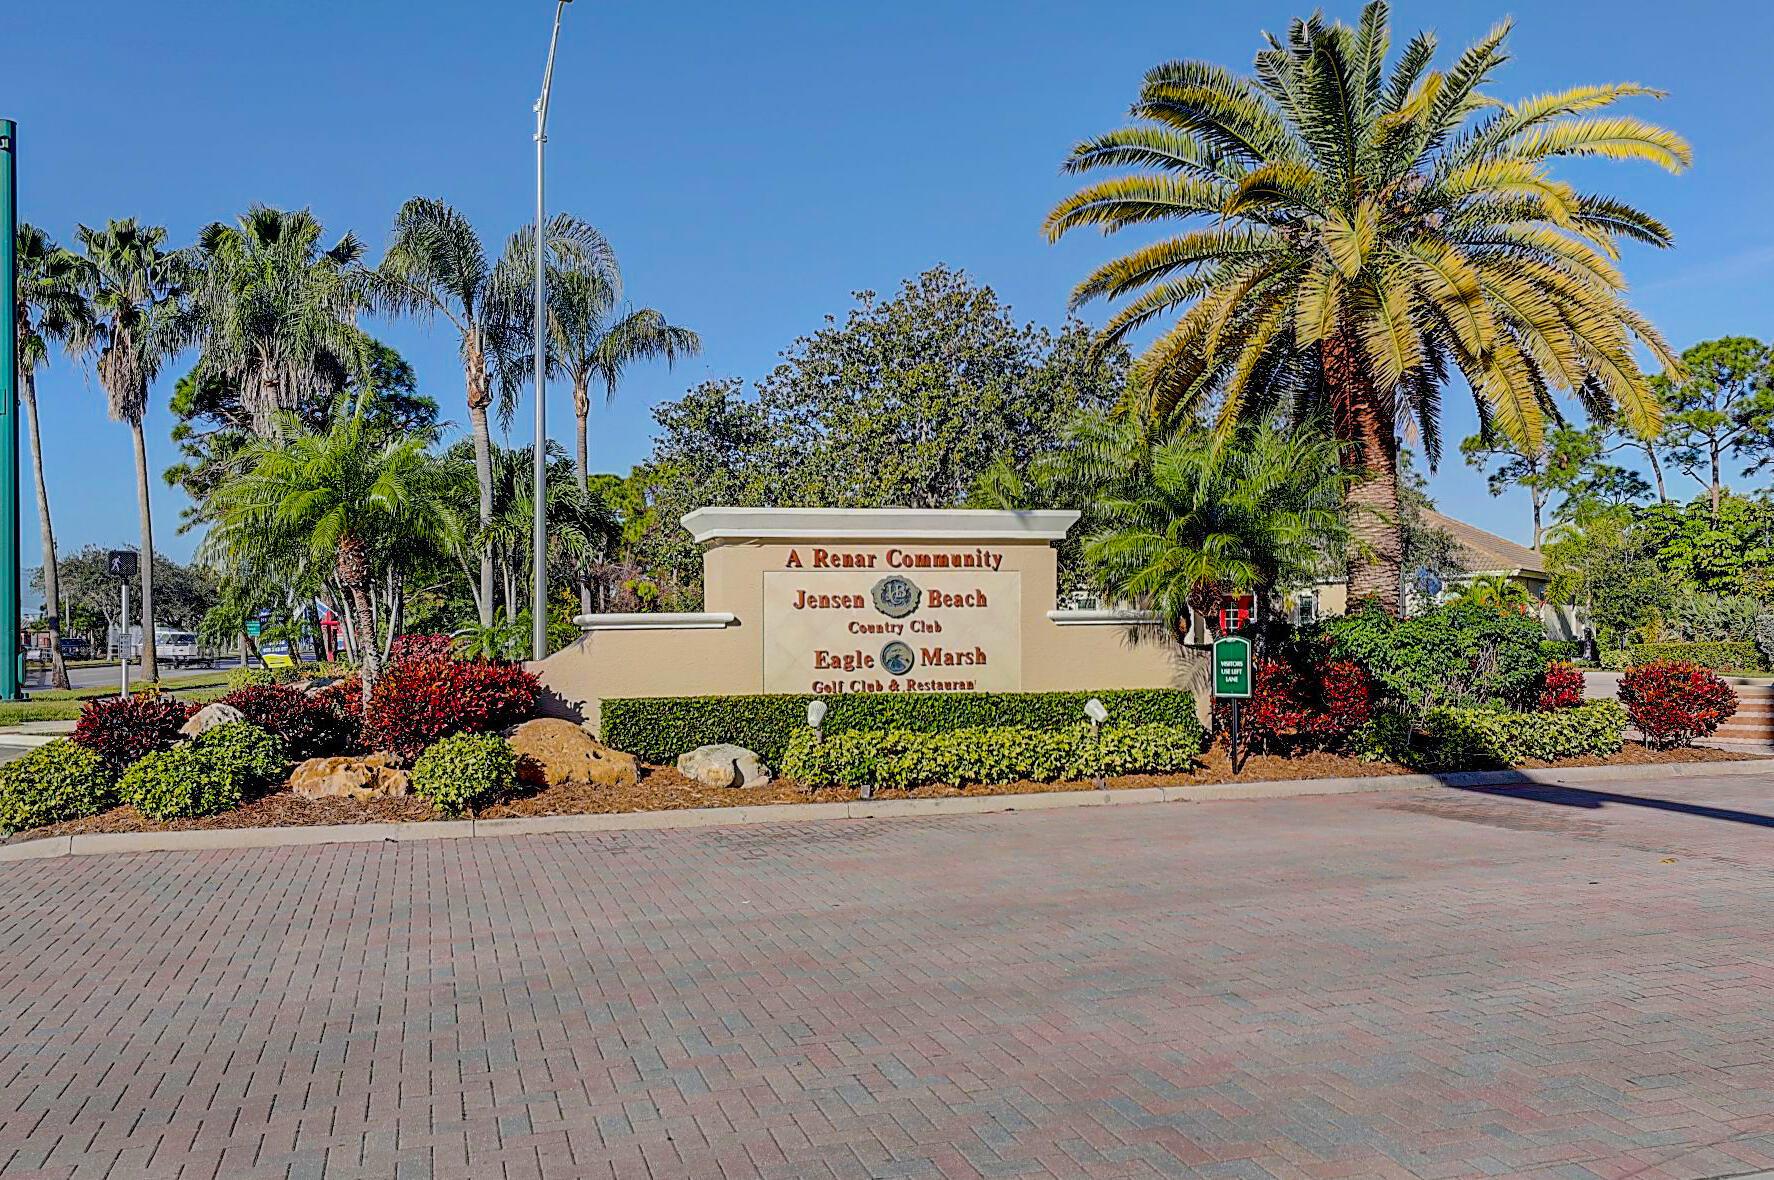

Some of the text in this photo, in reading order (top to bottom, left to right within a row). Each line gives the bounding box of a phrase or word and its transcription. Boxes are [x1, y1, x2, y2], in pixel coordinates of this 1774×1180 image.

[786, 548, 1003, 571] A Renar Community
[793, 589, 987, 609] Jensen Beach
[848, 620, 942, 635] Country Club
[814, 647, 987, 671] Eagle Marsh
[812, 678, 977, 693] Golf Club & Restauran
